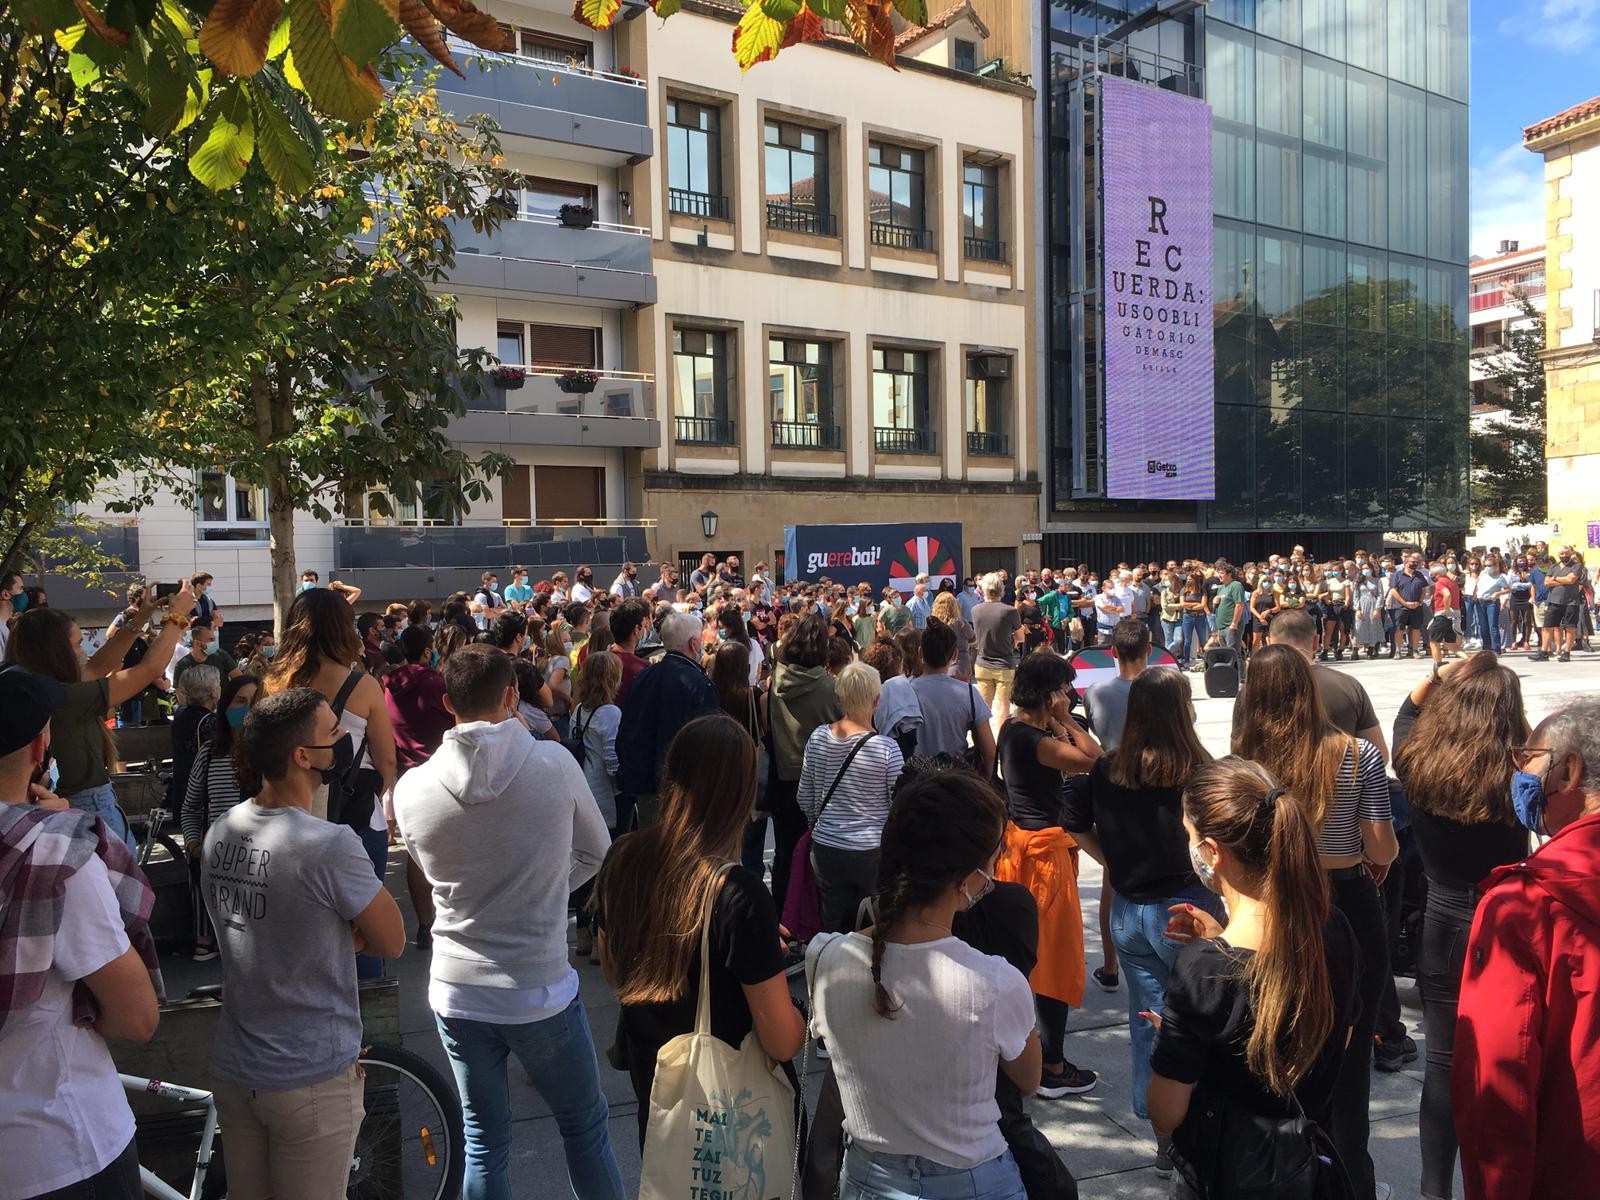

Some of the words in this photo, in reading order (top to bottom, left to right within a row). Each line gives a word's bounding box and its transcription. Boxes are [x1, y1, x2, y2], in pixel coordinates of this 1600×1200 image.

[1148, 195, 1169, 236] R
[1117, 302, 1199, 327] USOOBLI
[1122, 326, 1195, 344] GATORIO
[1135, 345, 1183, 359] DEMASC
[210, 840, 271, 878] SUPER
[209, 883, 267, 920] BRAND
[696, 1108, 728, 1126] MAI
[694, 1127, 713, 1143] TE
[692, 1147, 721, 1165] ZAI
[691, 1166, 722, 1184] TUZ
